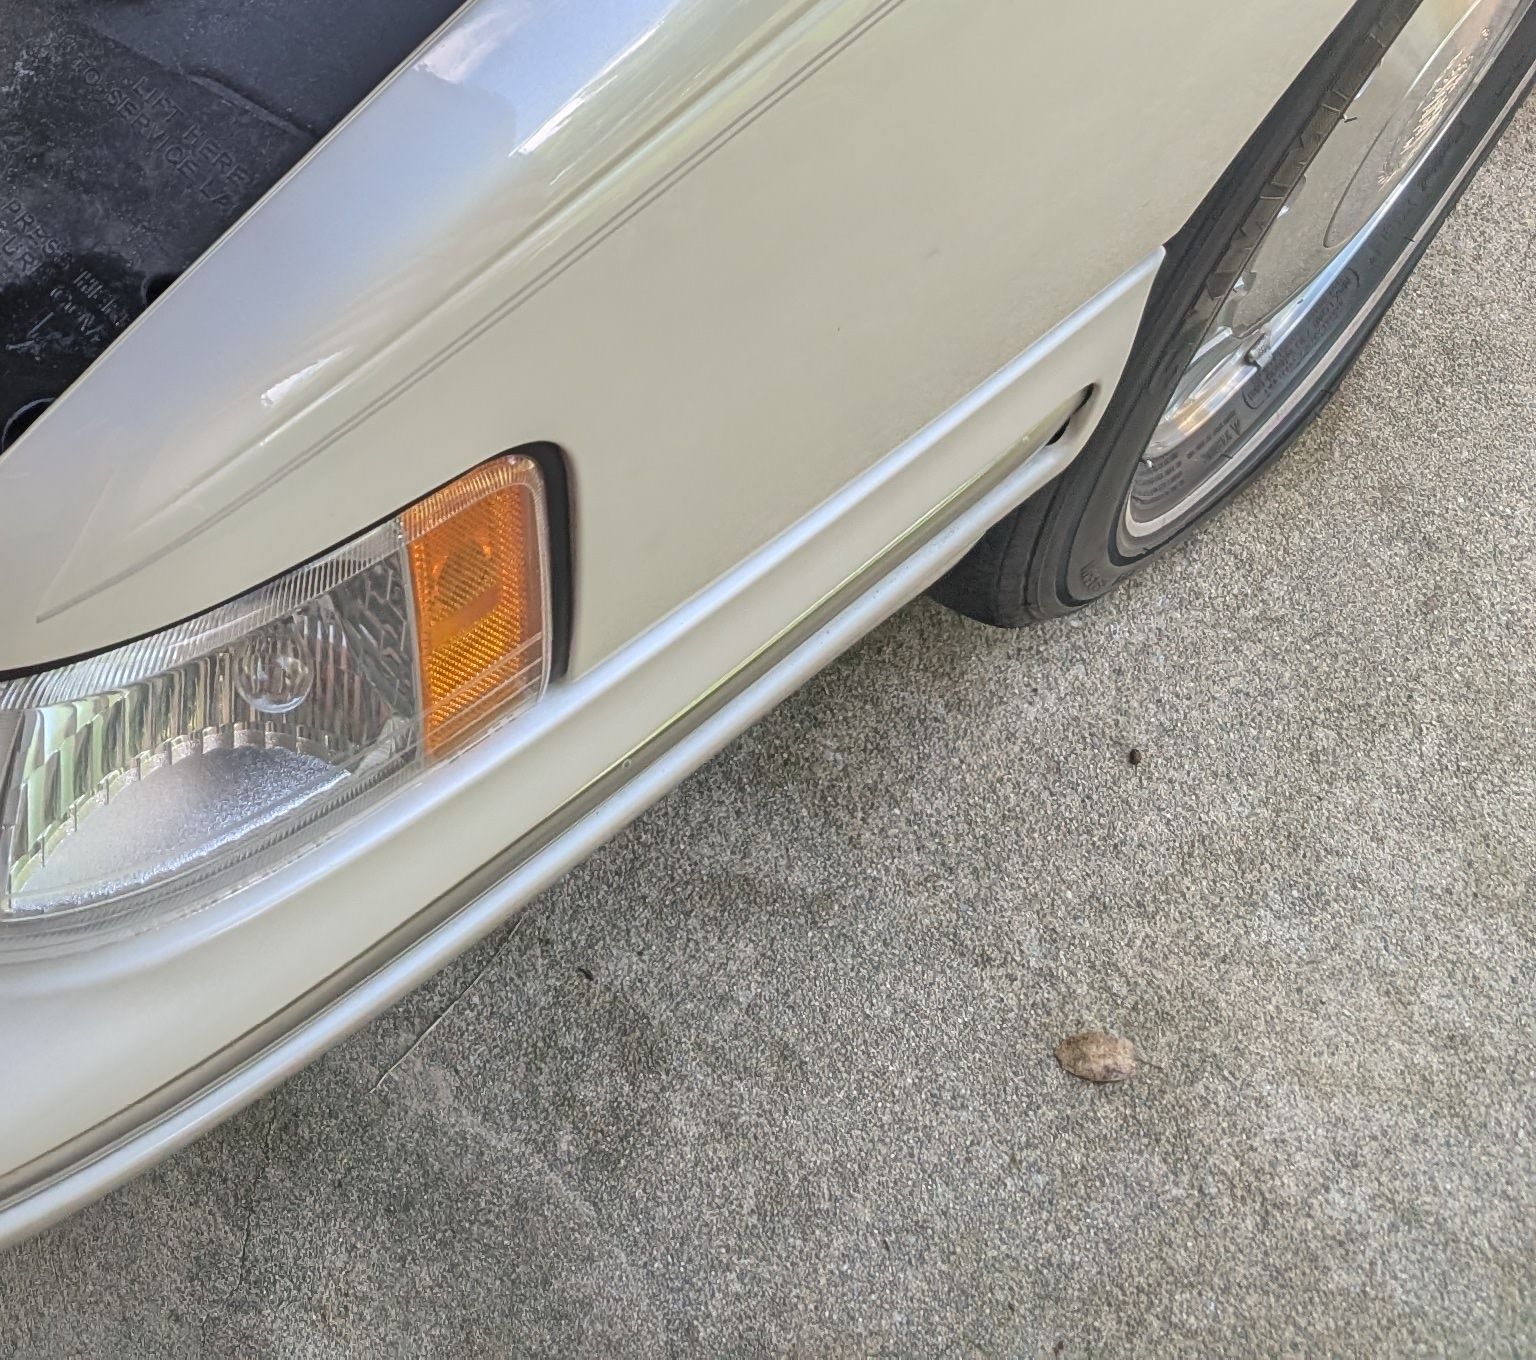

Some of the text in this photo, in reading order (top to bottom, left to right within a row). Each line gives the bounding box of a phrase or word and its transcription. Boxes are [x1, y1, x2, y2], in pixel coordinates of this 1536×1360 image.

[107, 88, 202, 180] SERVICE
[132, 76, 251, 187] LIFT HERE
[1, 197, 73, 272] PRESS
